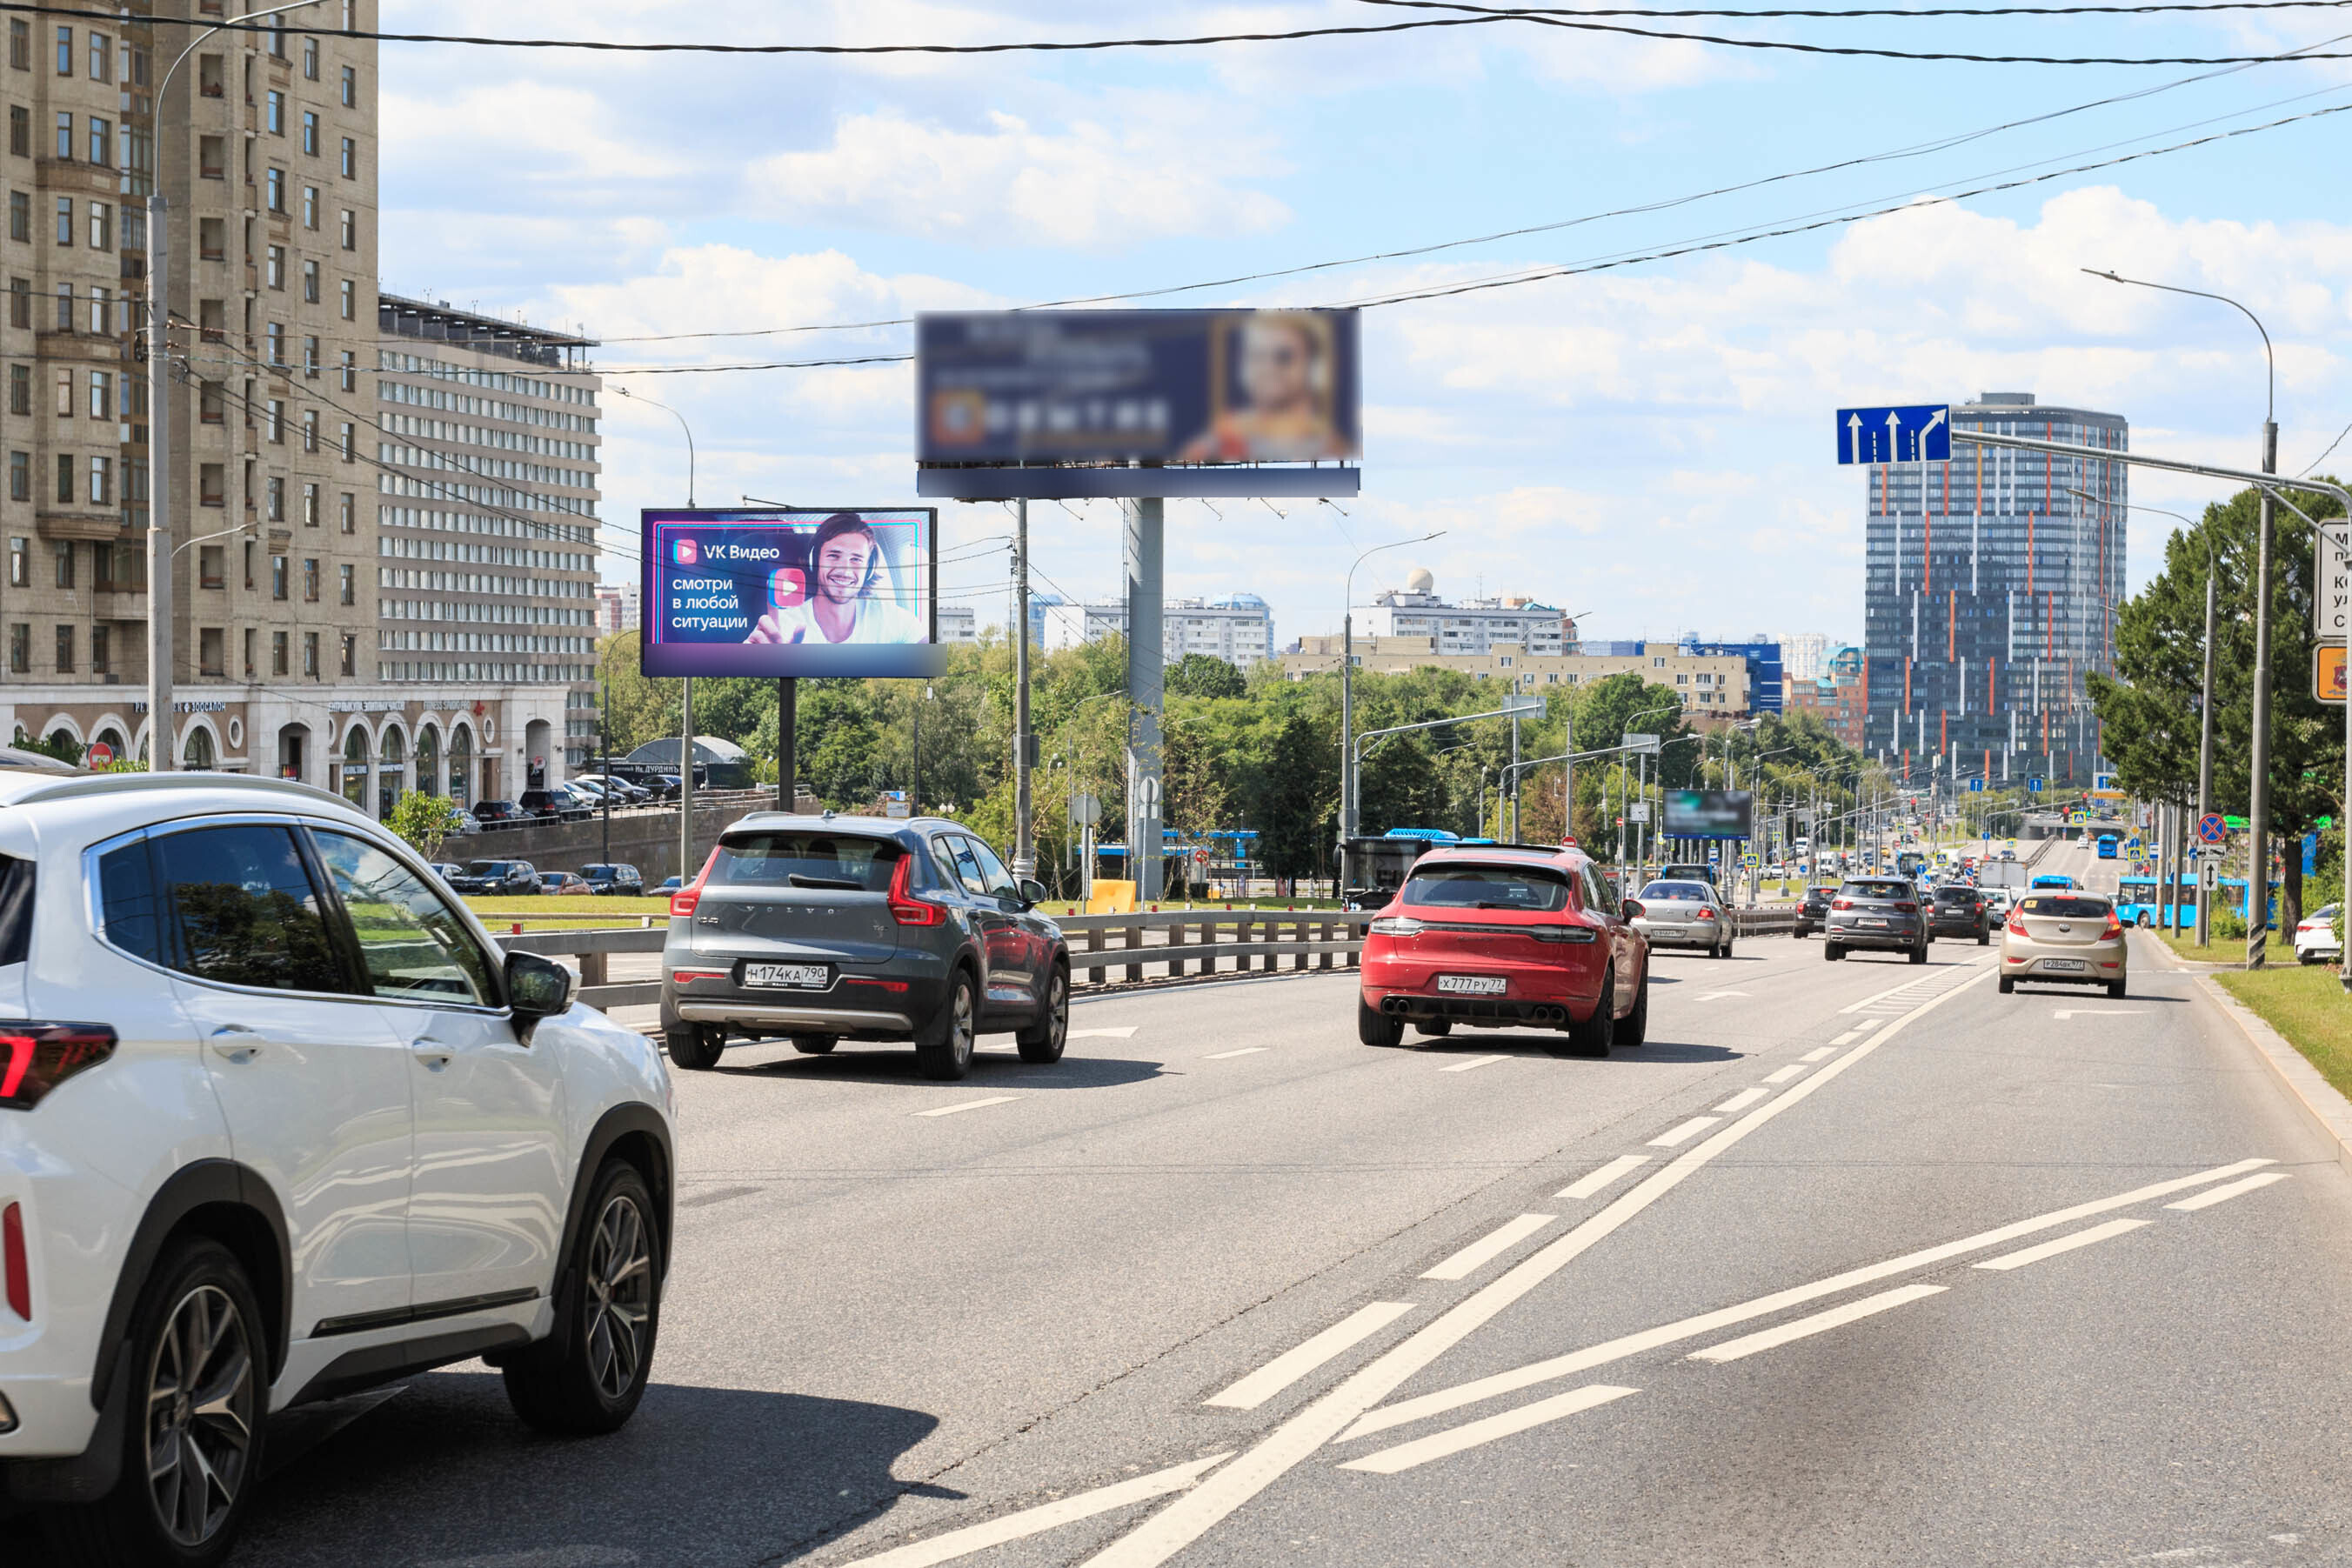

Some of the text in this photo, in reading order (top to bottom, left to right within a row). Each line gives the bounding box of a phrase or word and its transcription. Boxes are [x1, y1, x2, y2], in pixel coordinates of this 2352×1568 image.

[2335, 532, 2348, 546] М
[704, 544, 780, 562] VK Видео
[672, 578, 733, 593] смотри
[672, 594, 738, 610] в любой
[672, 617, 748, 631] ситуации
[2334, 614, 2346, 627] С
[746, 905, 835, 915] VOLVO
[804, 967, 825, 977] 790
[1491, 978, 1502, 988] 77
